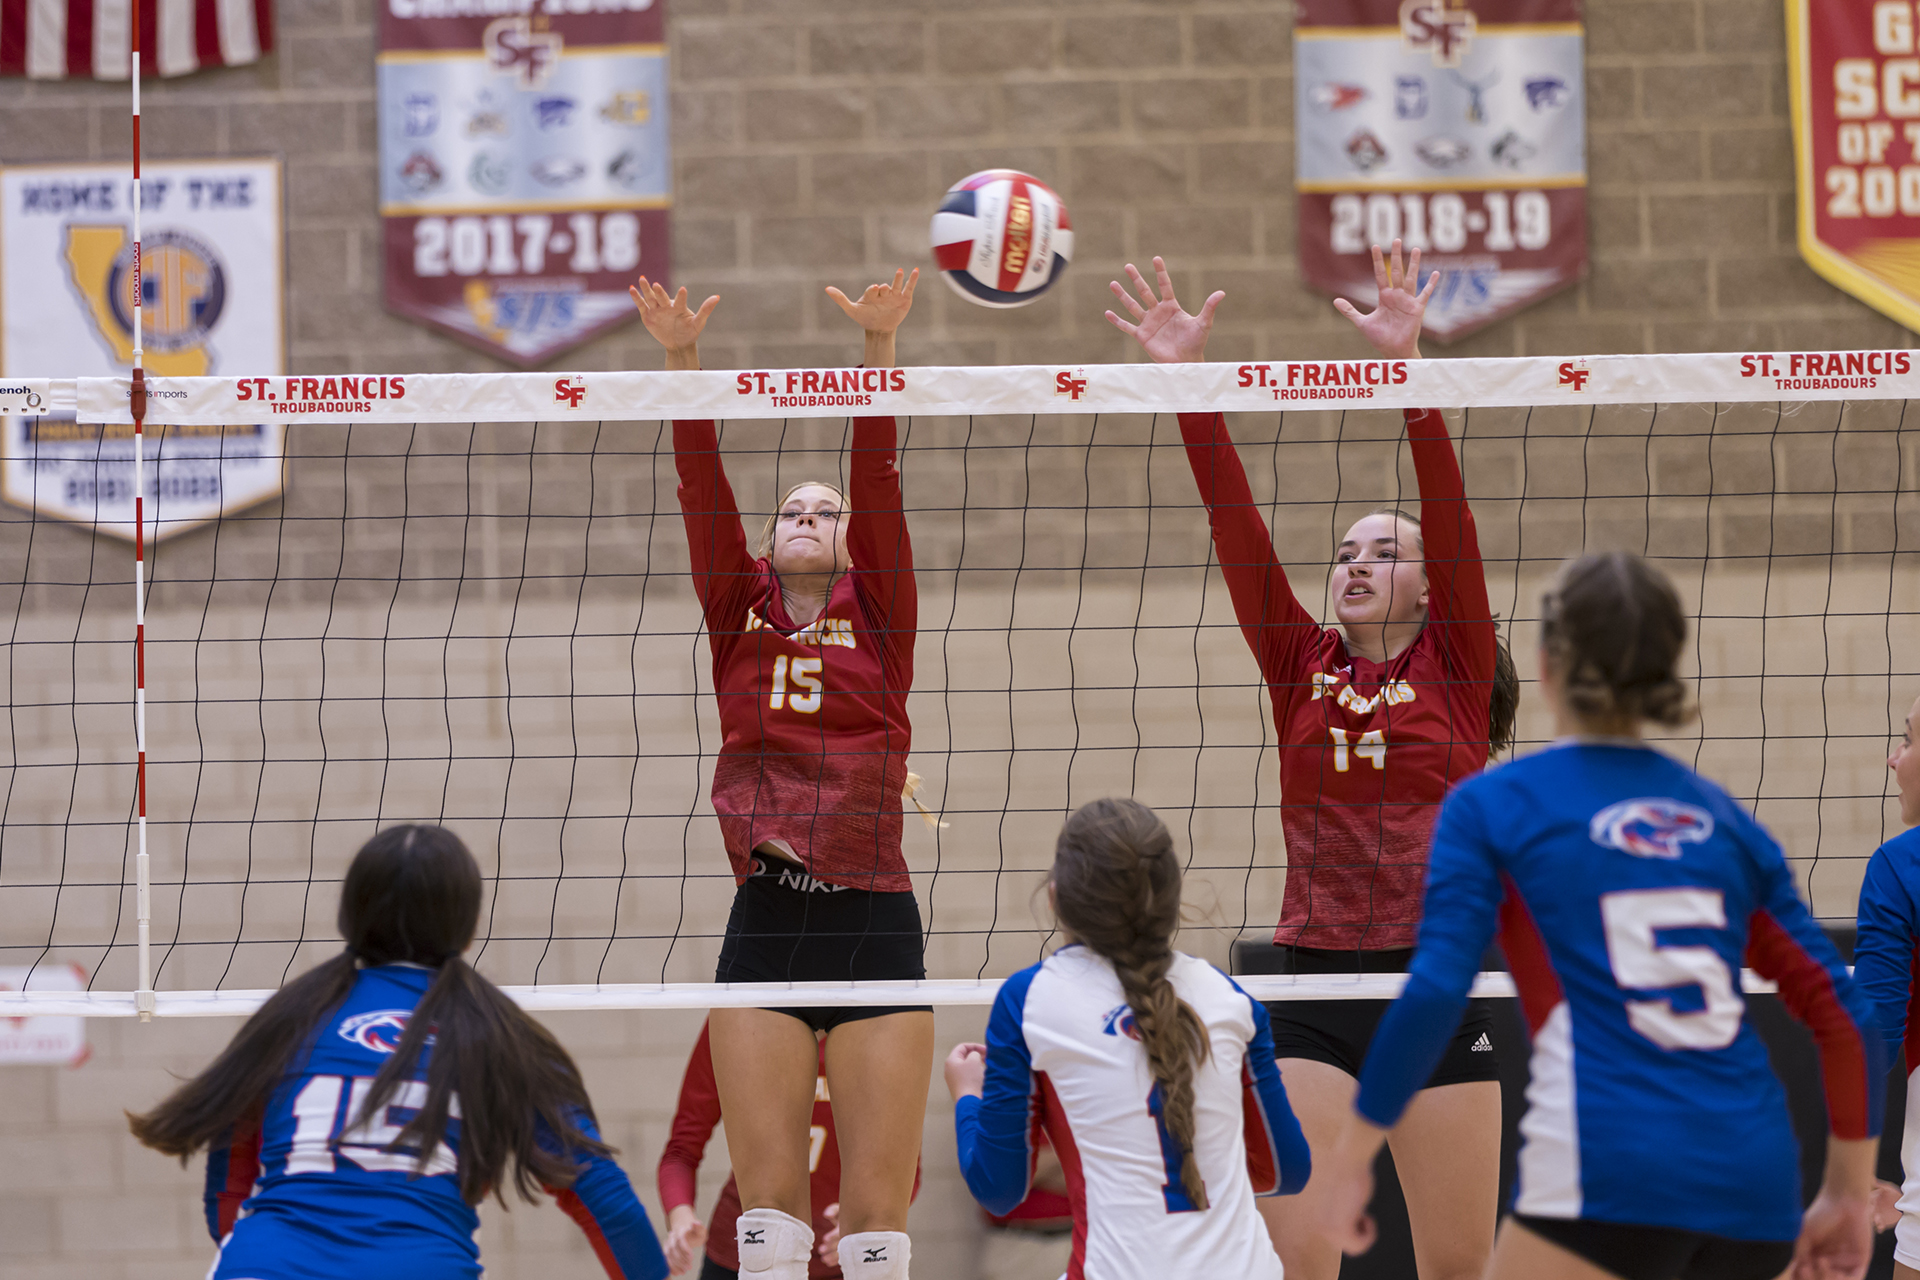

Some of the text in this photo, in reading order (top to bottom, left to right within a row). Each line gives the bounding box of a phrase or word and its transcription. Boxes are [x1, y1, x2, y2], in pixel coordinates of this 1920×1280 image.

[1873, 0, 1920, 55] G
[1837, 122, 1894, 164] OF
[1004, 195, 1032, 274] molten
[1329, 189, 1550, 254] 2018-19
[413, 211, 642, 278] 2017-18
[1237, 362, 1408, 387] ST. FRANCIS
[1558, 360, 1592, 393] SF
[1740, 352, 1911, 377] ST. FRANCIS
[236, 377, 405, 401] ST. FRANCIS
[553, 376, 588, 410] SF
[736, 369, 906, 395] ST. FRANCIS
[1054, 370, 1089, 402] SF
[1272, 387, 1374, 400] TROUBADOURS
[1775, 378, 1877, 390] TROUBADOURS
[271, 402, 372, 413] TROUBADOURS
[771, 394, 872, 407] TROUBADOURS
[769, 654, 824, 714] 15
[1329, 726, 1388, 773] 14
[1600, 888, 1746, 1052] 5
[1471, 1044, 1493, 1052] adidas
[283, 1074, 460, 1178] 15
